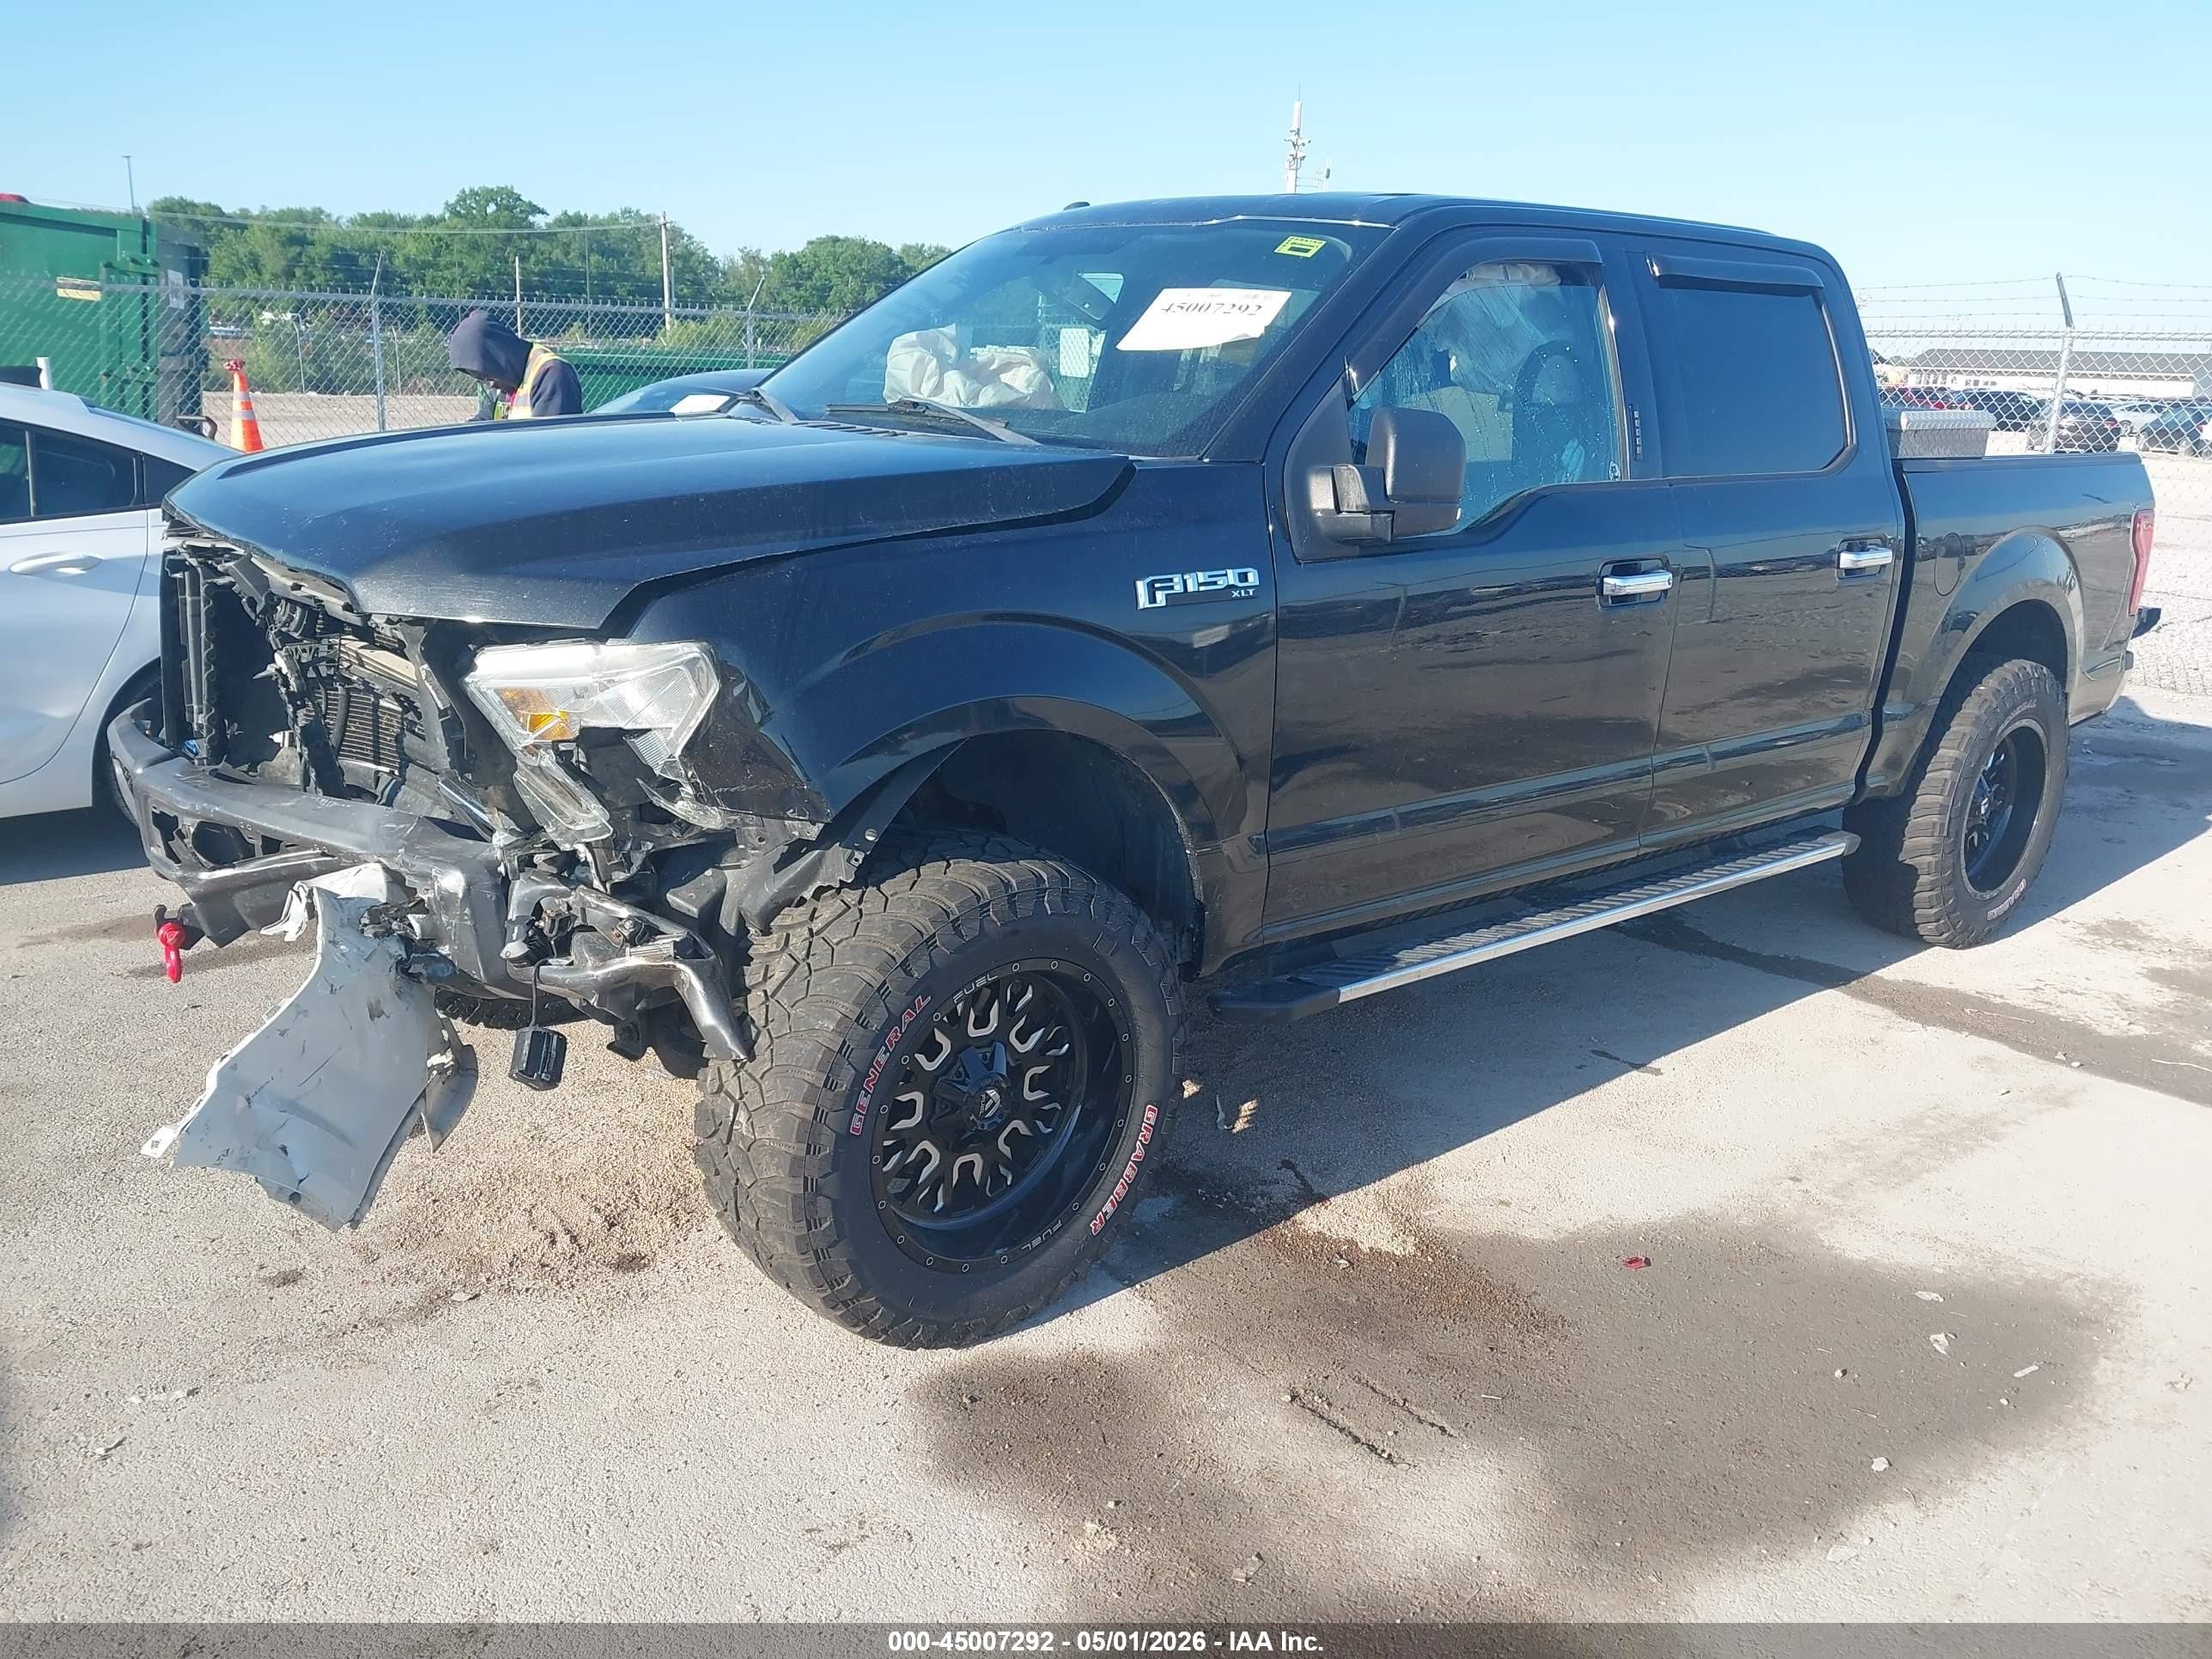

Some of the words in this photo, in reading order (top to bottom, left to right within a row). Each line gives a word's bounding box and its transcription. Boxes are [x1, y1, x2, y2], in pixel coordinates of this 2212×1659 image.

[1161, 302, 1262, 315] 45007292
[1231, 588, 1256, 598] XLT
[952, 974, 999, 1005] FUEL
[850, 994, 932, 1135] GENERAL
[1090, 1104, 1158, 1236] GRABBER
[1021, 1219, 1063, 1251] FUEL
